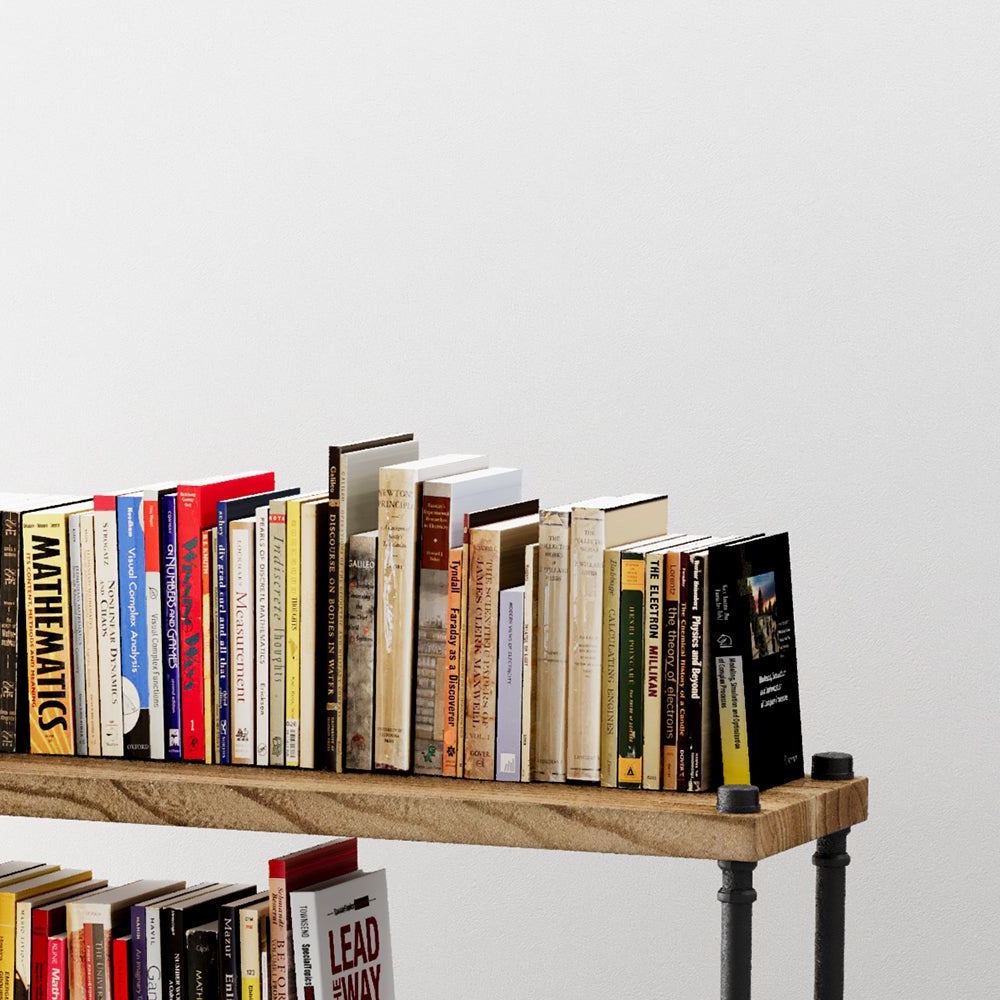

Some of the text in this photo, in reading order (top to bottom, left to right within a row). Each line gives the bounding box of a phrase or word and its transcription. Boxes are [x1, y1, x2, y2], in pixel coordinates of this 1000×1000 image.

[450, 560, 460, 592] Tyndall
[32, 535, 67, 730] MATHEMATICS
[128, 548, 140, 672] Visual Complex Analysis
[273, 536, 288, 682] Indiscrete Thoughts
[448, 608, 459, 645] Faraday
[648, 561, 659, 697] THE ELECTRON MILLIKAN
[667, 608, 677, 626] the
[236, 592, 248, 704] Measurement
[449, 650, 456, 661] as
[666, 631, 676, 667] theory
[690, 616, 701, 699] Physics and Beyond
[448, 674, 458, 727] Discoverer
[667, 671, 676, 681] of
[666, 687, 676, 738] electrons
[224, 919, 232, 958] Mazur
[328, 916, 380, 976] LEAD
